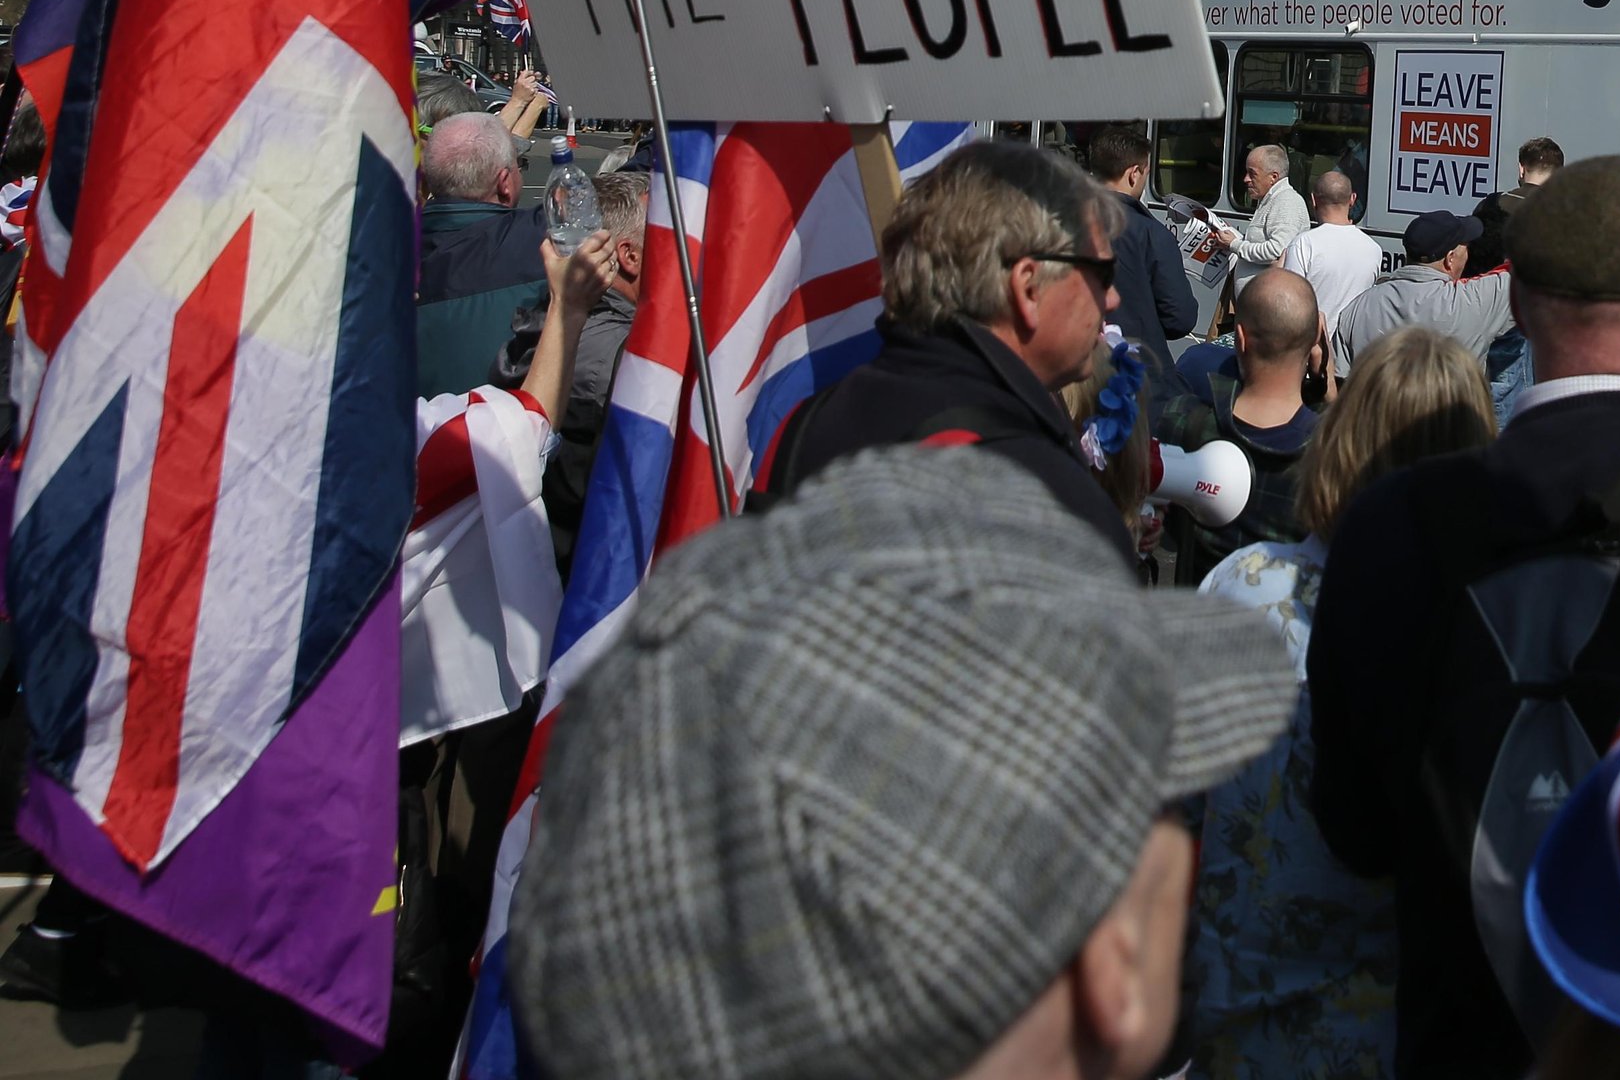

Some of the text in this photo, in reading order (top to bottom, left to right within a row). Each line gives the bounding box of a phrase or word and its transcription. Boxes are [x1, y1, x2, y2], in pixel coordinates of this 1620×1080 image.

[1234, 0, 1279, 26] what
[1401, 72, 1494, 110] LEAVE
[1410, 120, 1480, 149] MEANS
[1396, 157, 1490, 198] LEAVE
[1184, 225, 1209, 253] LET'S
[1201, 237, 1217, 253] GO
[1208, 249, 1228, 268] WT
[1195, 480, 1221, 496] PYLE
